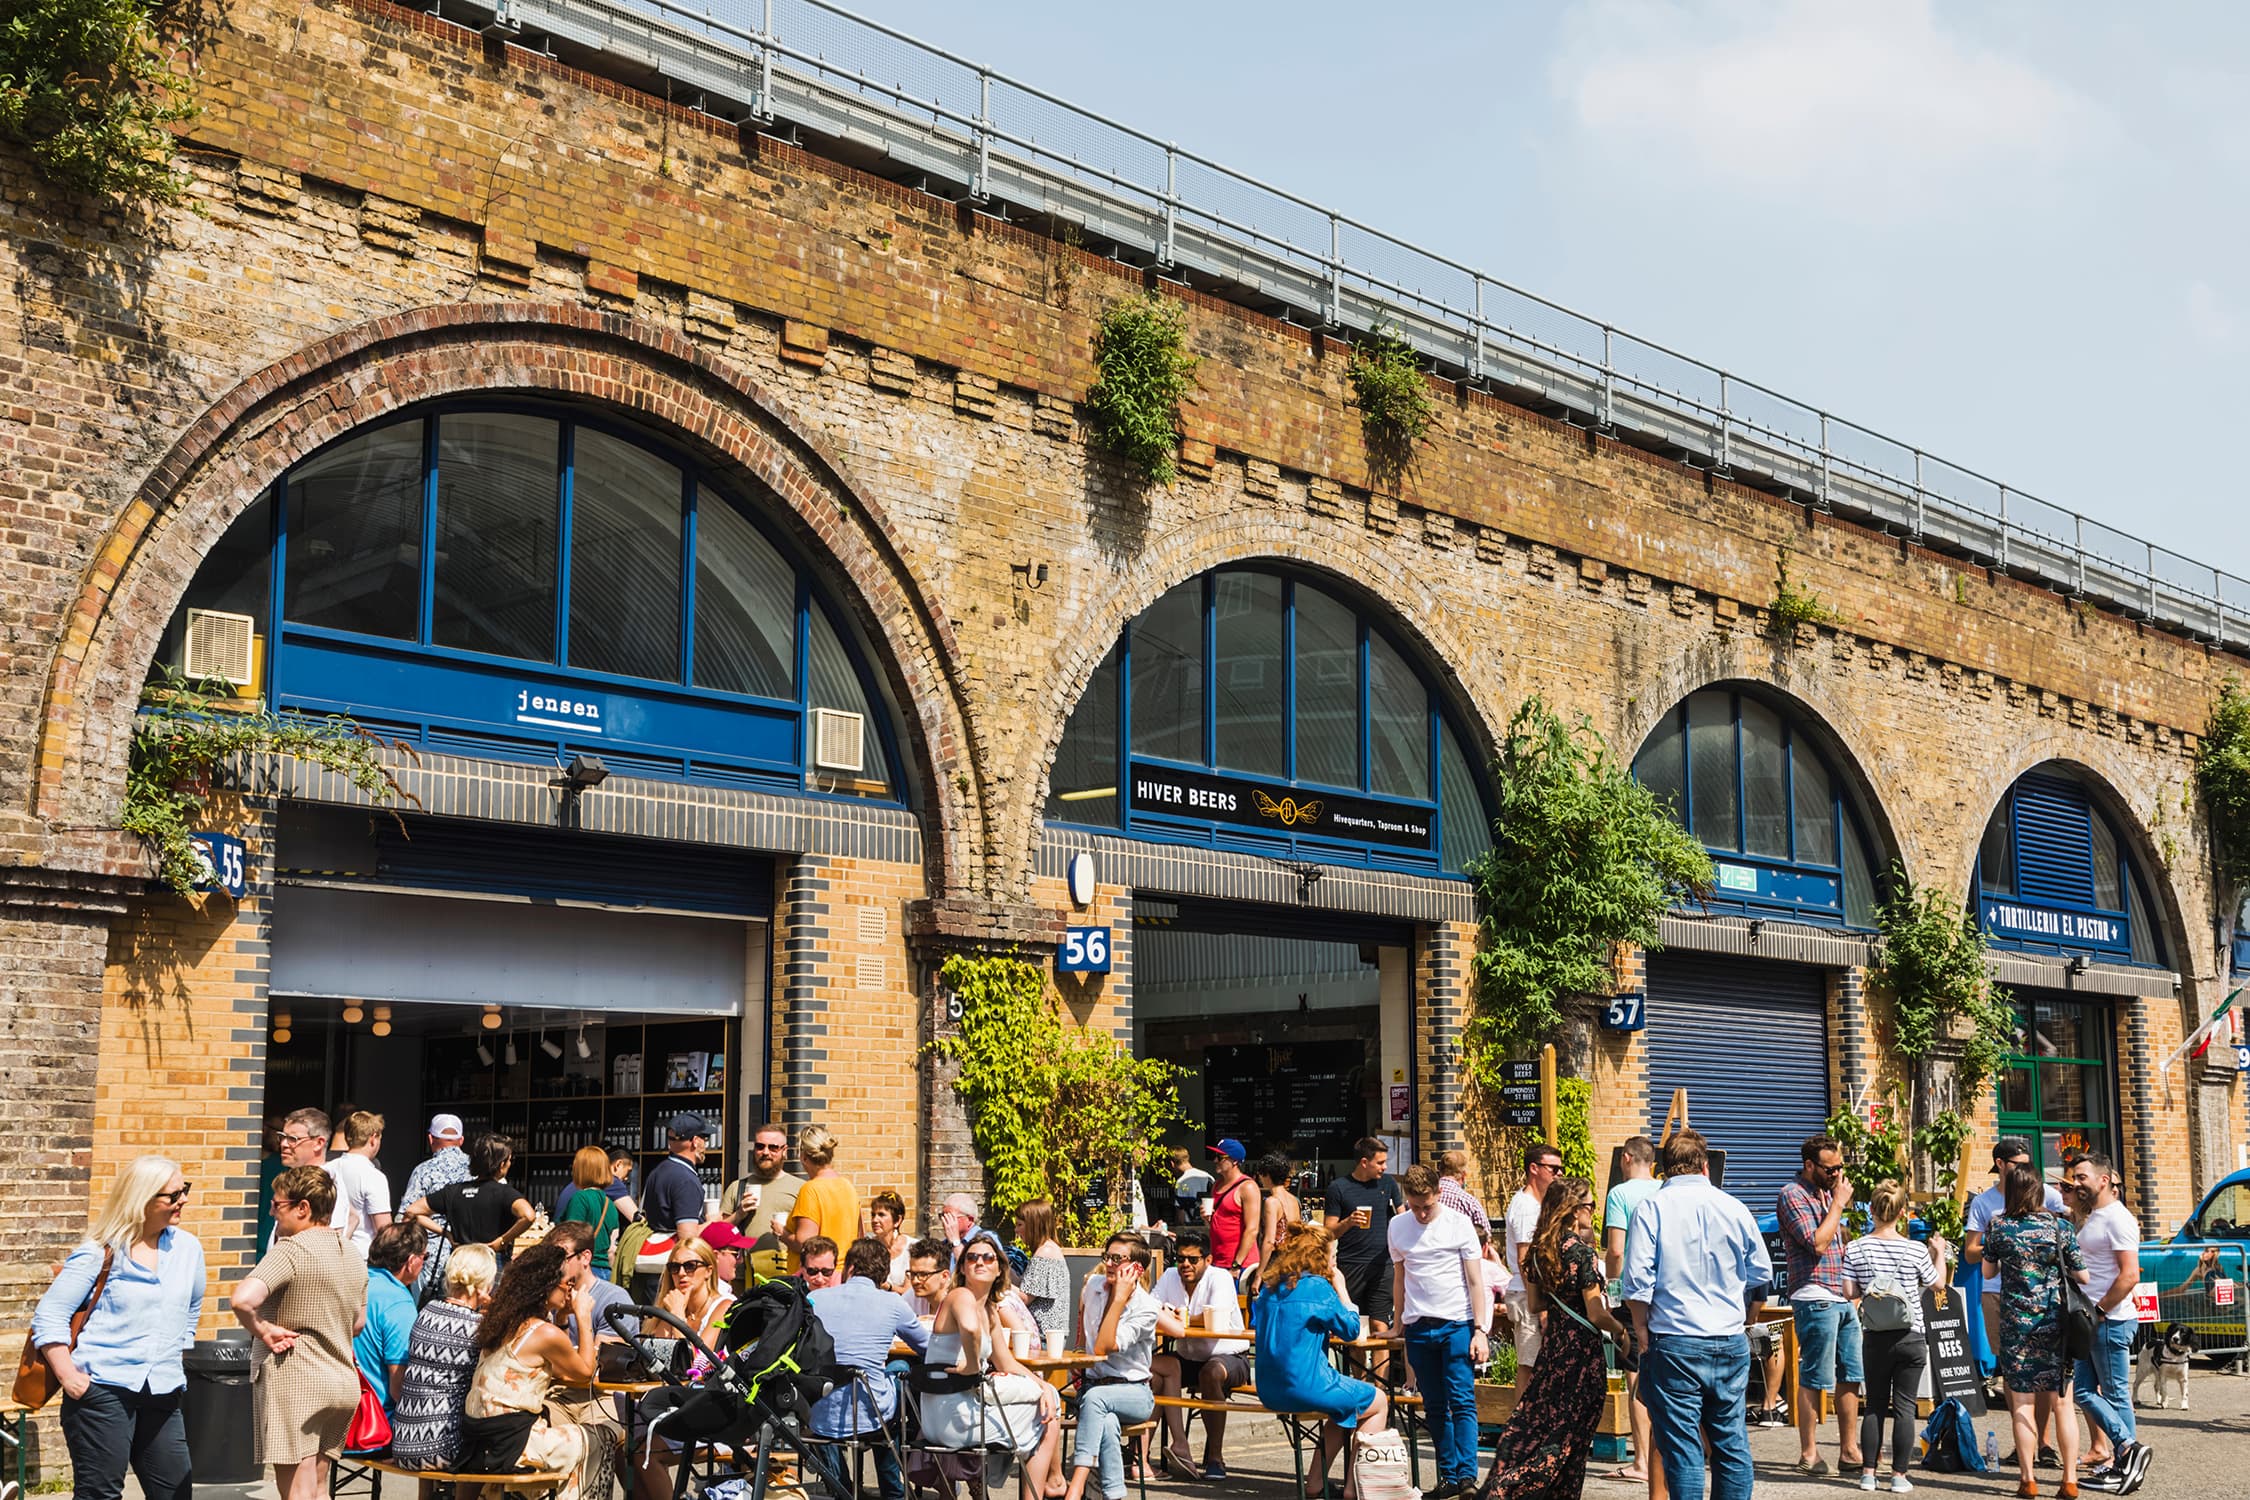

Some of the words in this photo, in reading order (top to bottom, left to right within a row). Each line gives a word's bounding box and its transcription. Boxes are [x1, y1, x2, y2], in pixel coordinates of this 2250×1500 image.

[518, 690, 599, 718] jensen
[1138, 780, 1182, 804] HIVER
[1189, 788, 1237, 811] BEERS
[1333, 813, 1376, 829] Hivequarters,
[1378, 821, 1403, 832] Taproom
[1405, 824, 1409, 832] &
[1411, 825, 1426, 836] Shop
[222, 843, 243, 888] 55
[1999, 905, 2059, 934] TORTILLERIA
[2062, 915, 2075, 936] EL
[2077, 917, 2110, 942] PASTOR
[1066, 931, 1106, 965] 56
[1610, 999, 1639, 1025] 57
[1770, 1238, 1780, 1248] all
[2141, 1297, 2150, 1307] No
[1930, 1320, 1960, 1329] BERMONDSEY
[1940, 1330, 1955, 1340] STREET
[1938, 1340, 1963, 1358] BEES
[1940, 1368, 1954, 1378] HERE
[1953, 1366, 1971, 1377] TODAY
